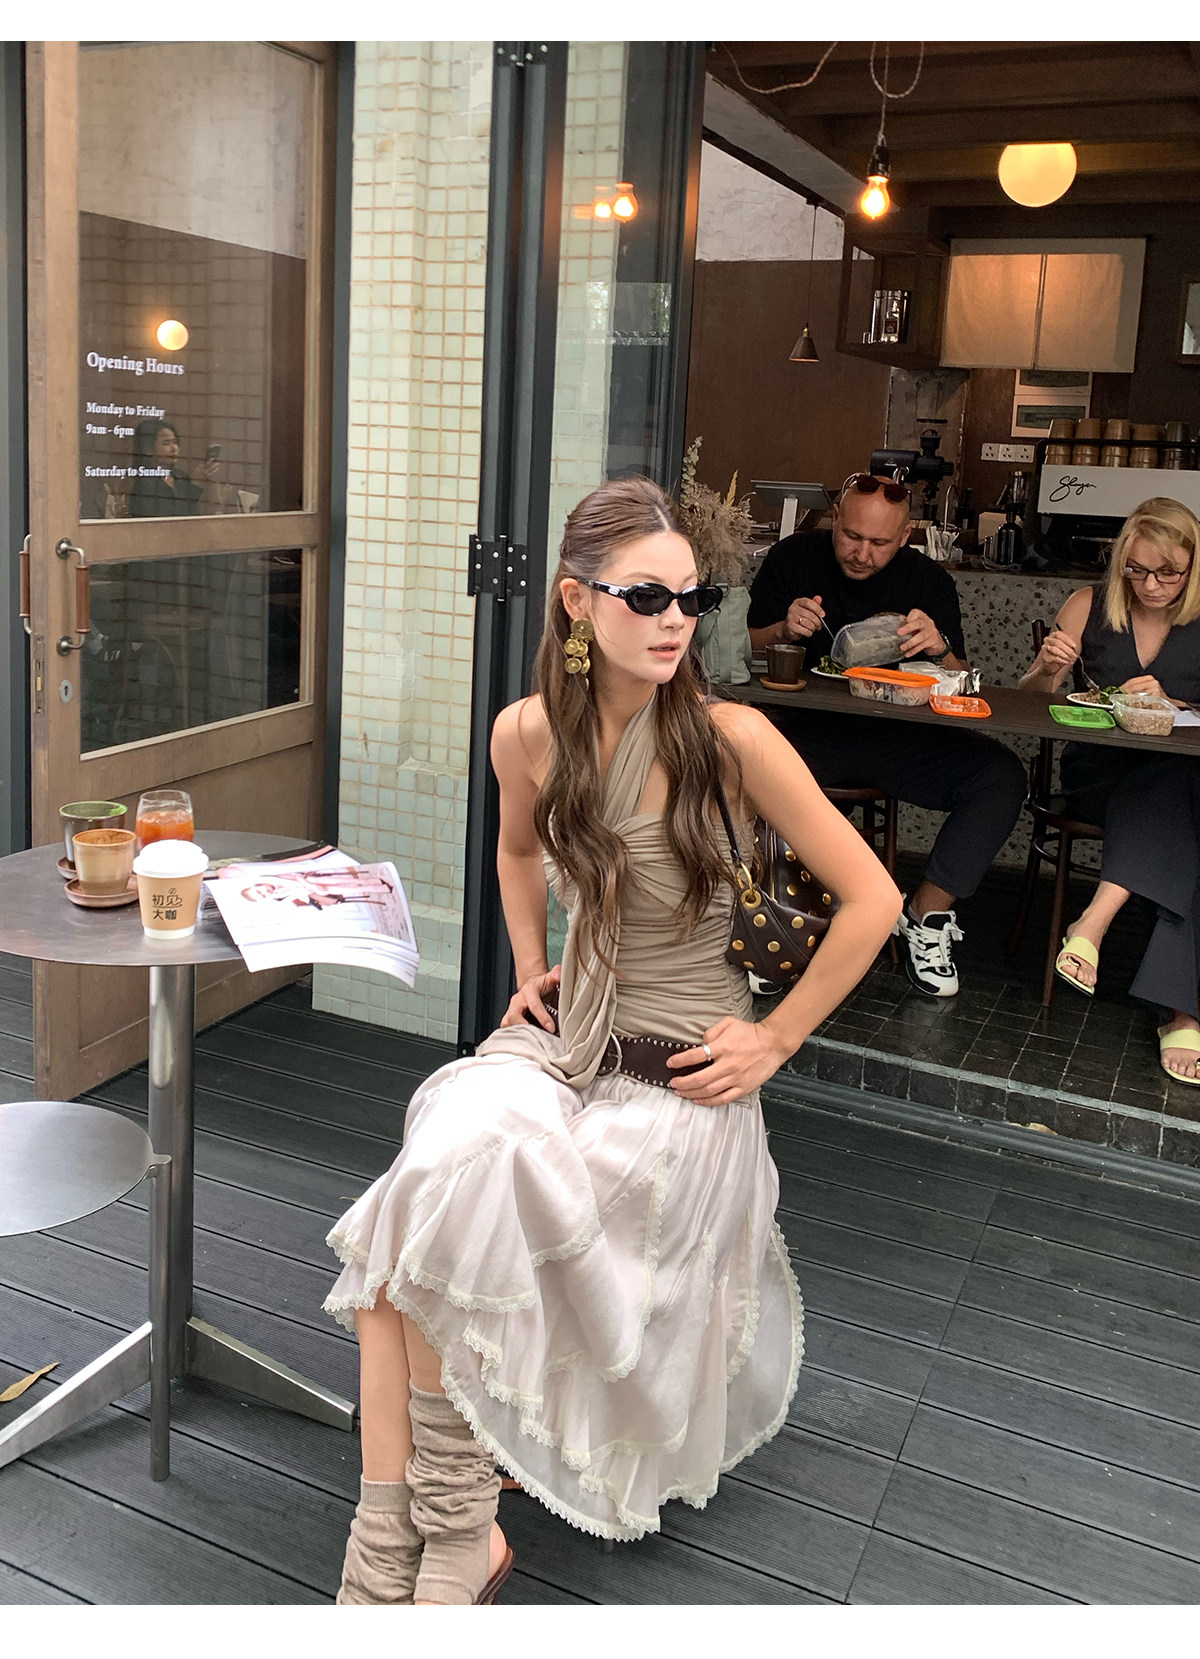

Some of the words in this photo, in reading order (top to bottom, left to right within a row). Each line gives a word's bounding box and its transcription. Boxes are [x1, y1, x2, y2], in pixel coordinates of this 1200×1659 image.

[87, 352, 144, 375] Opening
[146, 358, 184, 375] Hours
[86, 402, 124, 417] Monday
[125, 406, 135, 415] to
[136, 405, 165, 420] Friday
[85, 423, 107, 435] 9am
[113, 425, 135, 438] 6pm
[85, 466, 126, 479] Saturday
[127, 467, 137, 477] to
[138, 466, 171, 479] Sunday
[152, 894, 182, 907] 初见
[153, 909, 177, 920] 大咖
